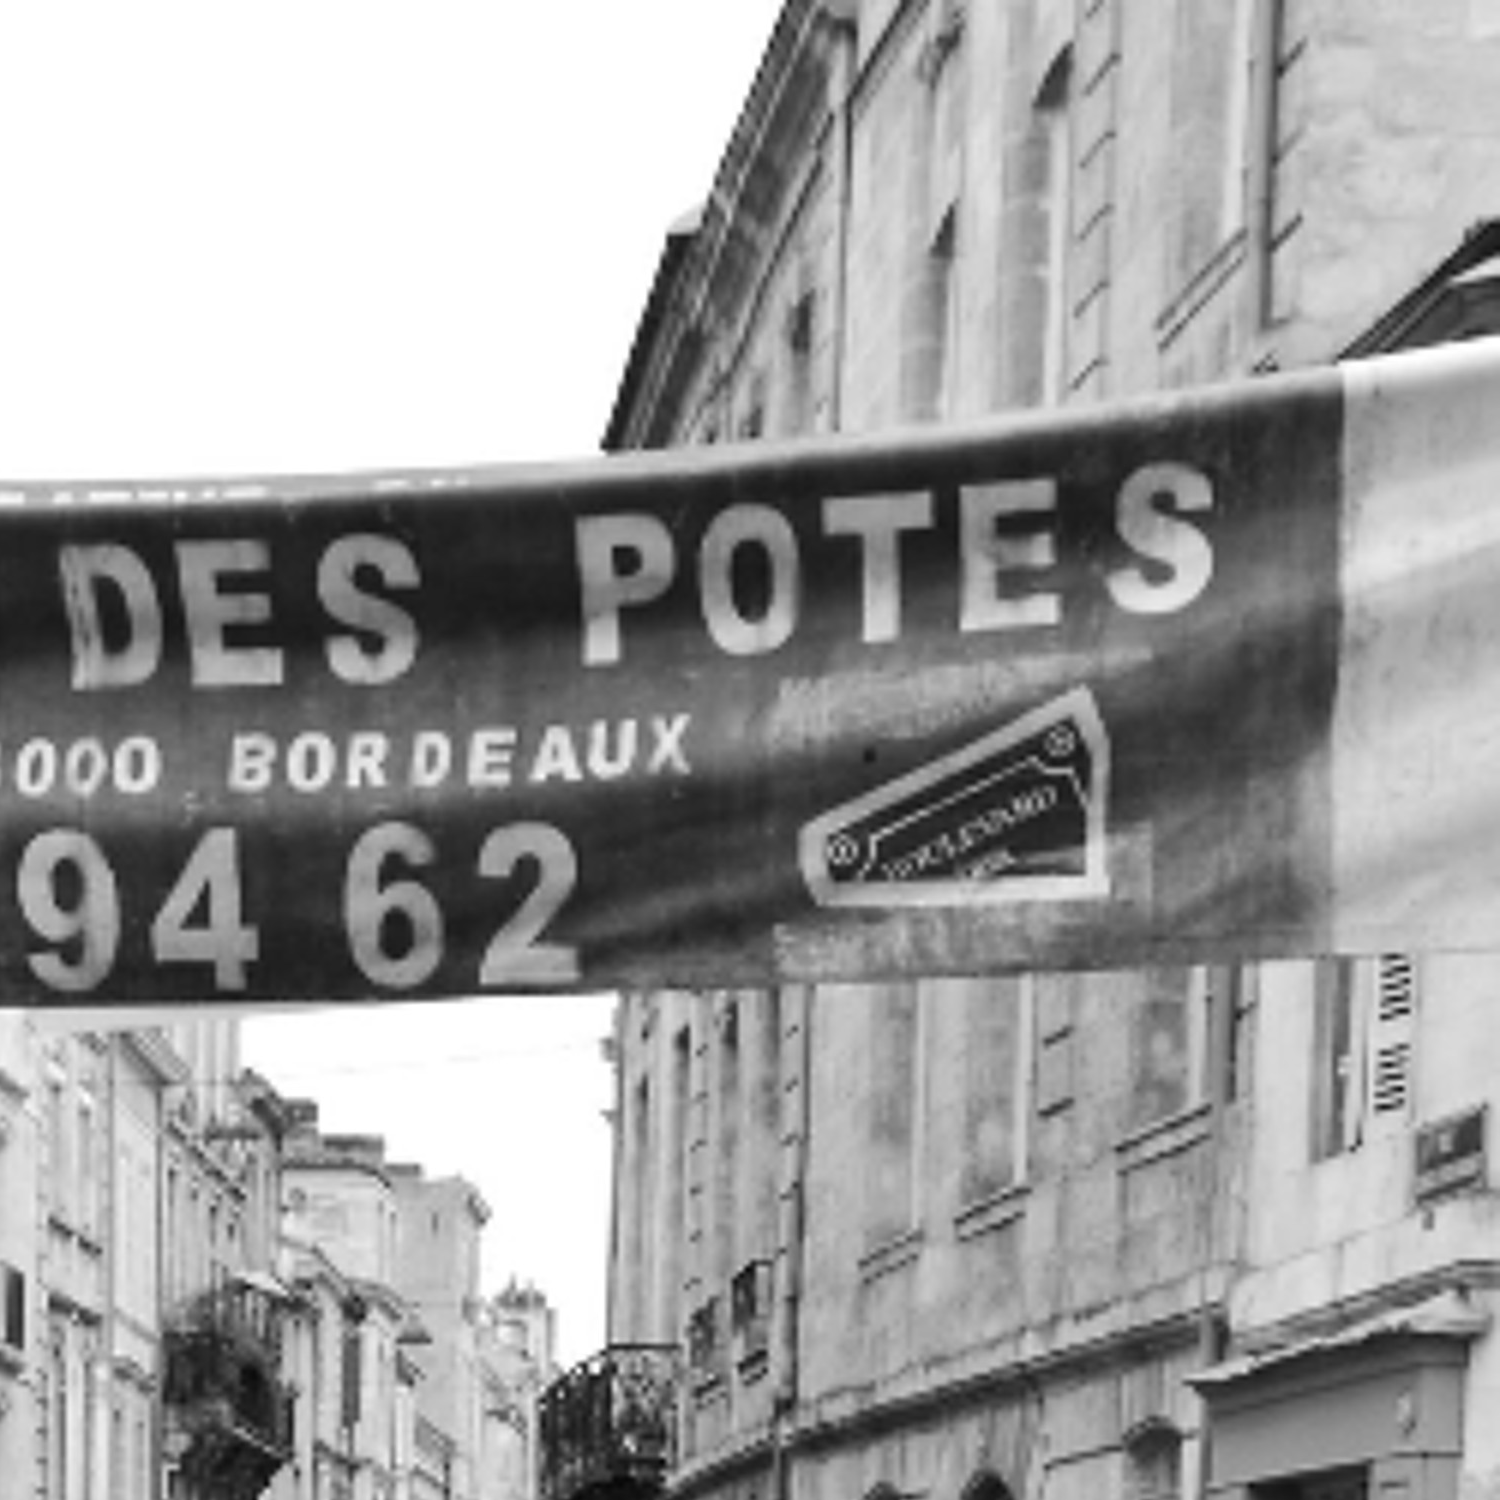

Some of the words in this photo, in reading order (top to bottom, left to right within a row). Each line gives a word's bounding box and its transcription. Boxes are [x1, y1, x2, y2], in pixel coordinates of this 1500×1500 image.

[59, 532, 421, 691] DES
[575, 461, 1214, 668] POTES
[227, 712, 692, 791] BORDEAUX
[344, 821, 582, 989] 62
